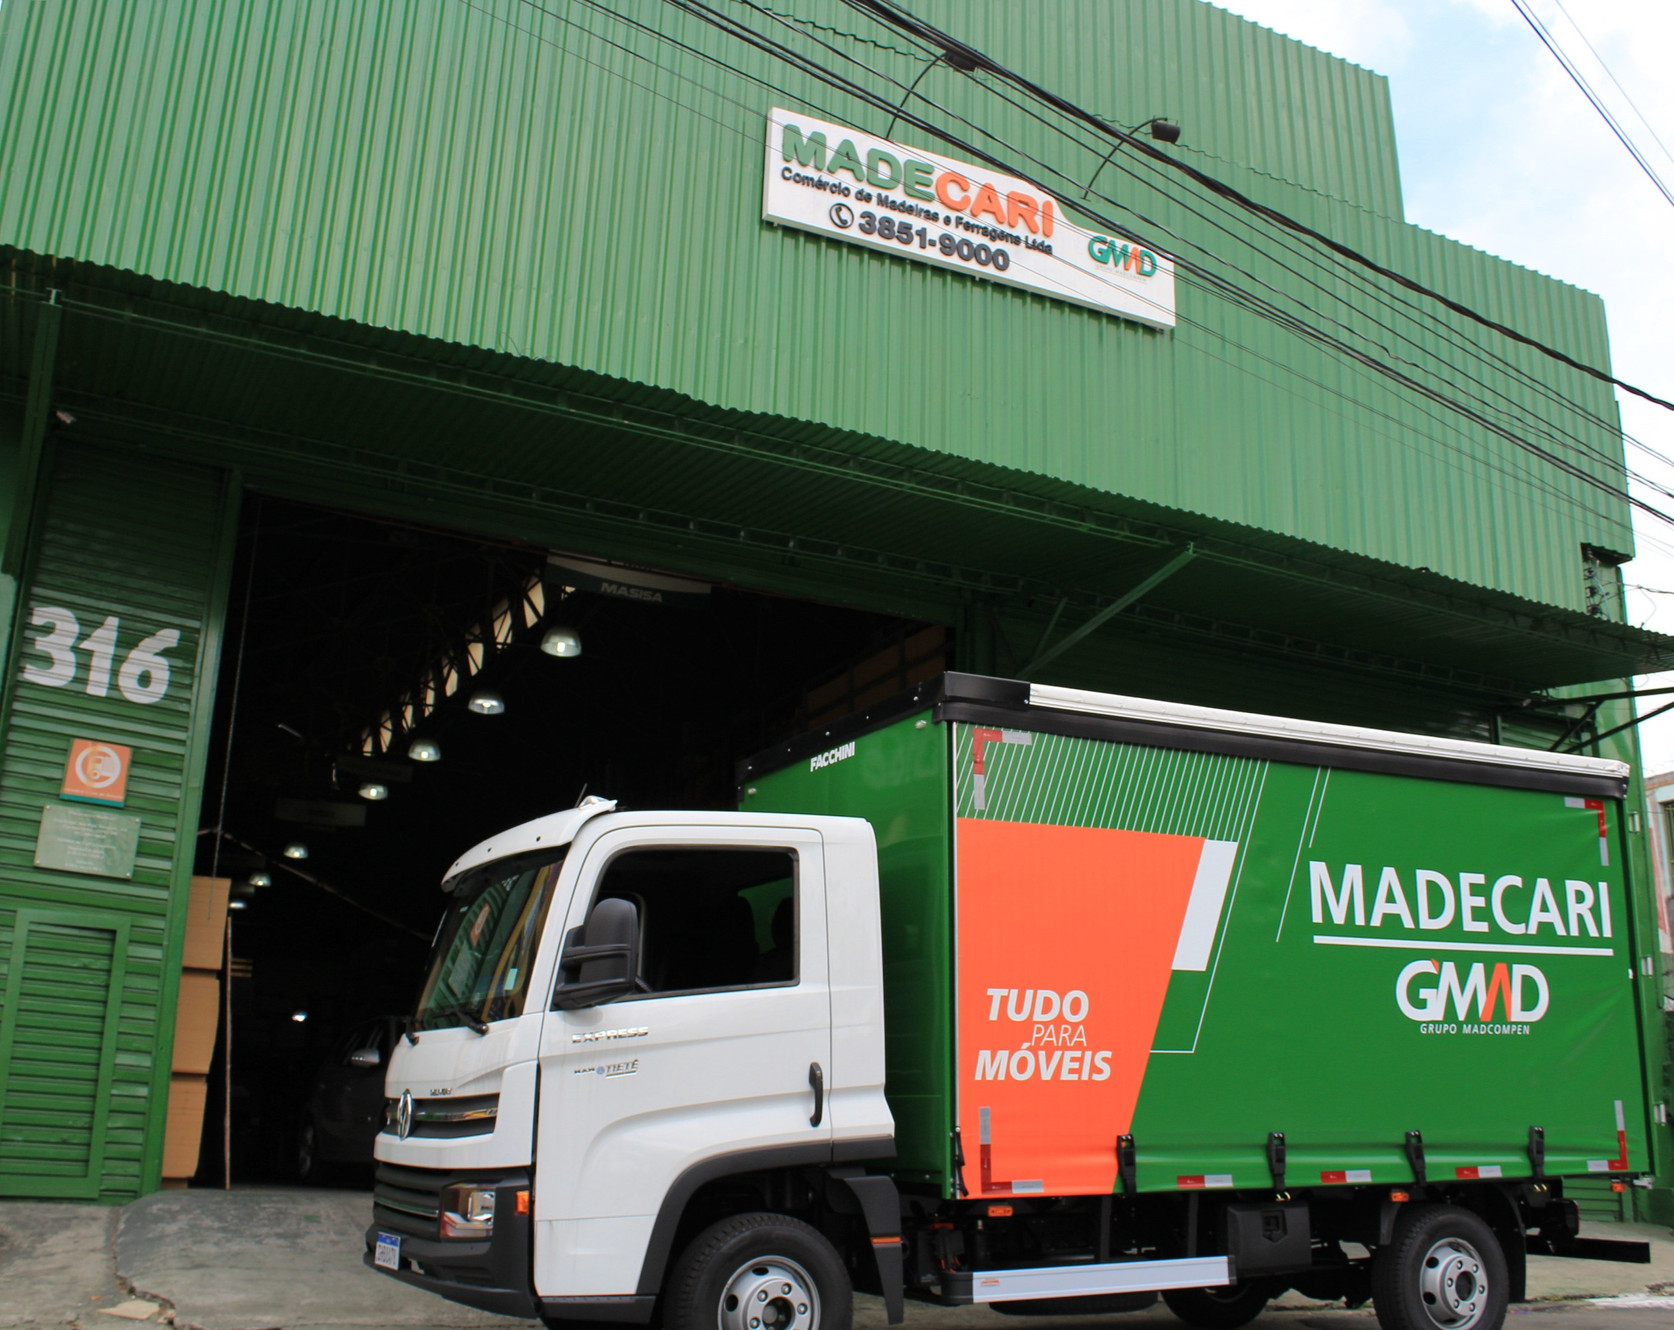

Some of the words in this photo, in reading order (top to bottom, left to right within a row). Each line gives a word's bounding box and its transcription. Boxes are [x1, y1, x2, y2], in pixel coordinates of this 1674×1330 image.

[782, 123, 1054, 238] MADECARI
[781, 166, 851, 198] Comércio
[855, 187, 873, 204] de
[876, 192, 940, 222] Madeiras
[943, 214, 953, 226] e
[955, 215, 1022, 246] Ferragens
[1025, 234, 1053, 255] Ltda
[858, 210, 1010, 271] 3851-9000
[23, 606, 181, 704] 316
[810, 741, 855, 772] FACCHINI
[1309, 860, 1613, 938] MADECARI
[986, 988, 1090, 1022] TUDO
[1395, 958, 1550, 1022] GMAD
[572, 1026, 649, 1043] EXPRESS
[1031, 1024, 1088, 1047] PARA
[1420, 1023, 1457, 1034] GRUPO
[1462, 1023, 1530, 1035] MADCOMPEN
[974, 1042, 1113, 1081] MÓVEIS
